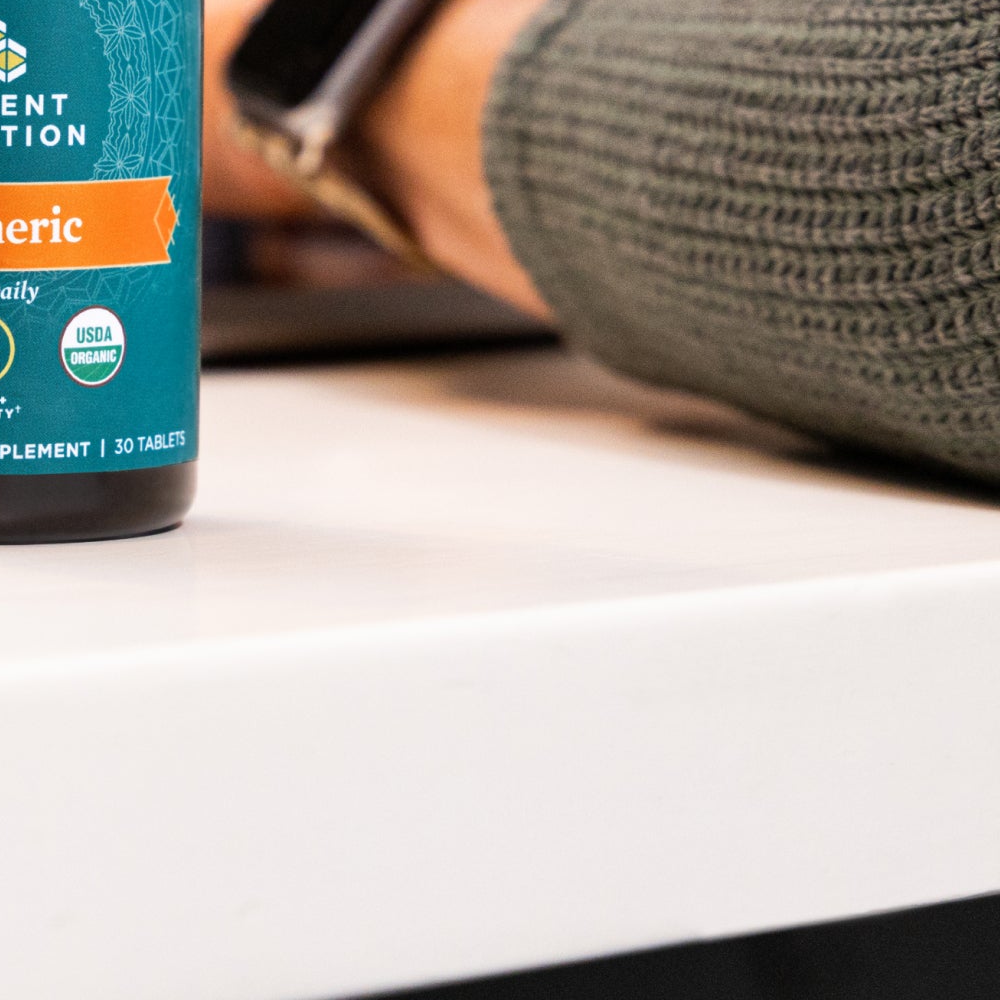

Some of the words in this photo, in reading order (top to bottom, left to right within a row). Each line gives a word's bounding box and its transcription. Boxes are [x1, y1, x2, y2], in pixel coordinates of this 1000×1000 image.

[76, 326, 113, 344] USDA
[70, 349, 117, 366] ORGANIC
[114, 438, 134, 455] 30
[137, 430, 186, 453] TABLETS
